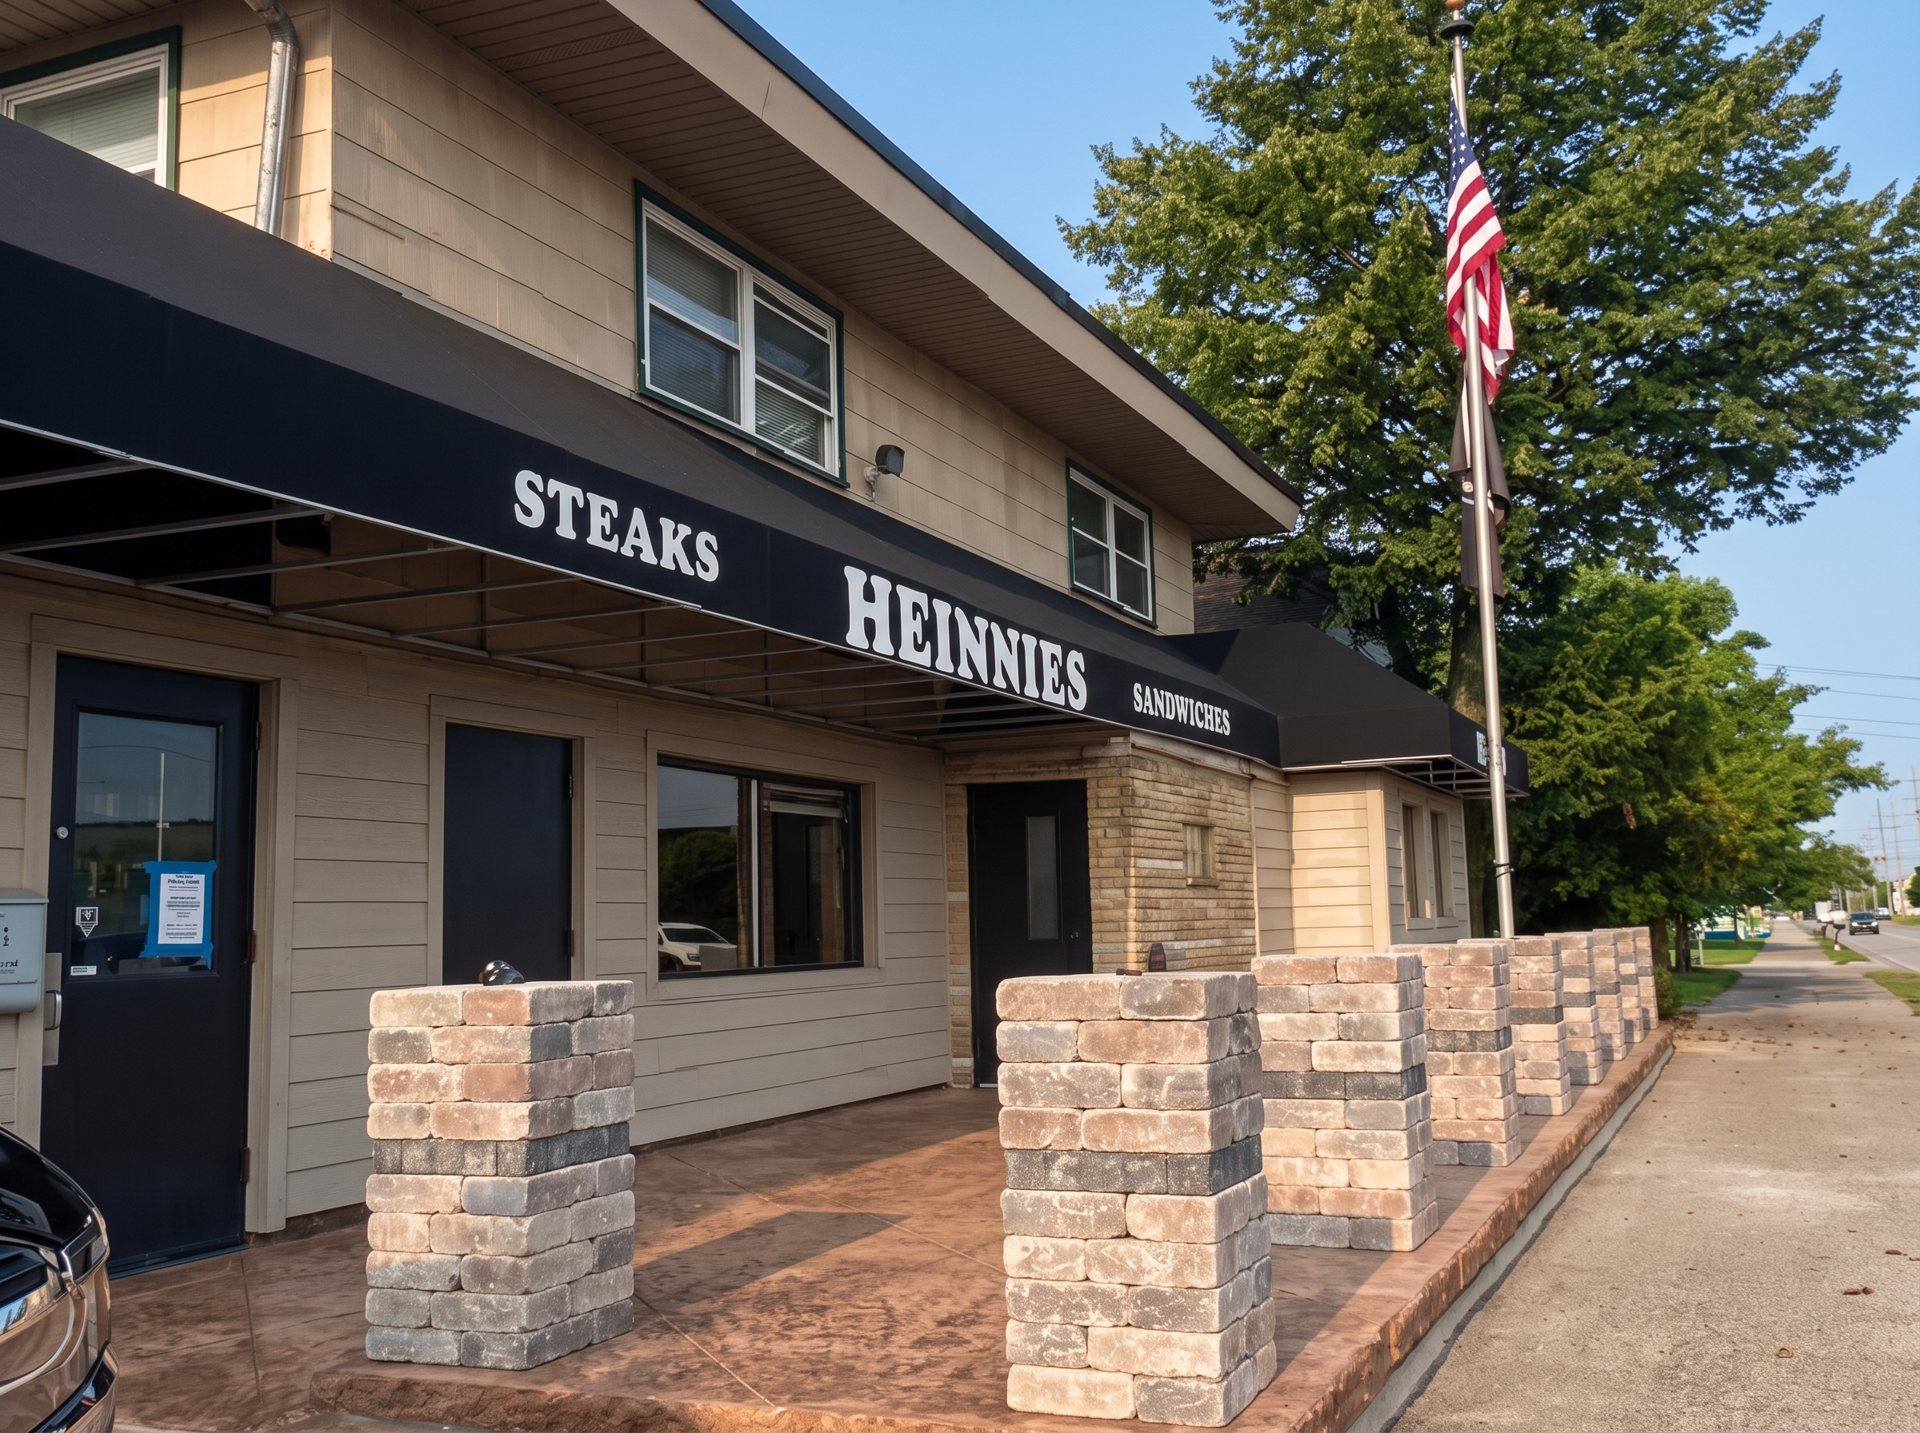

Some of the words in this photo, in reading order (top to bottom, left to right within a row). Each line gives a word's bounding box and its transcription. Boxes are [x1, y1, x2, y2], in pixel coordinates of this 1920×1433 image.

[513, 469, 720, 582] STEAKS
[843, 565, 1088, 712] HEINNIES
[1133, 682, 1231, 736] SANDWICHES
